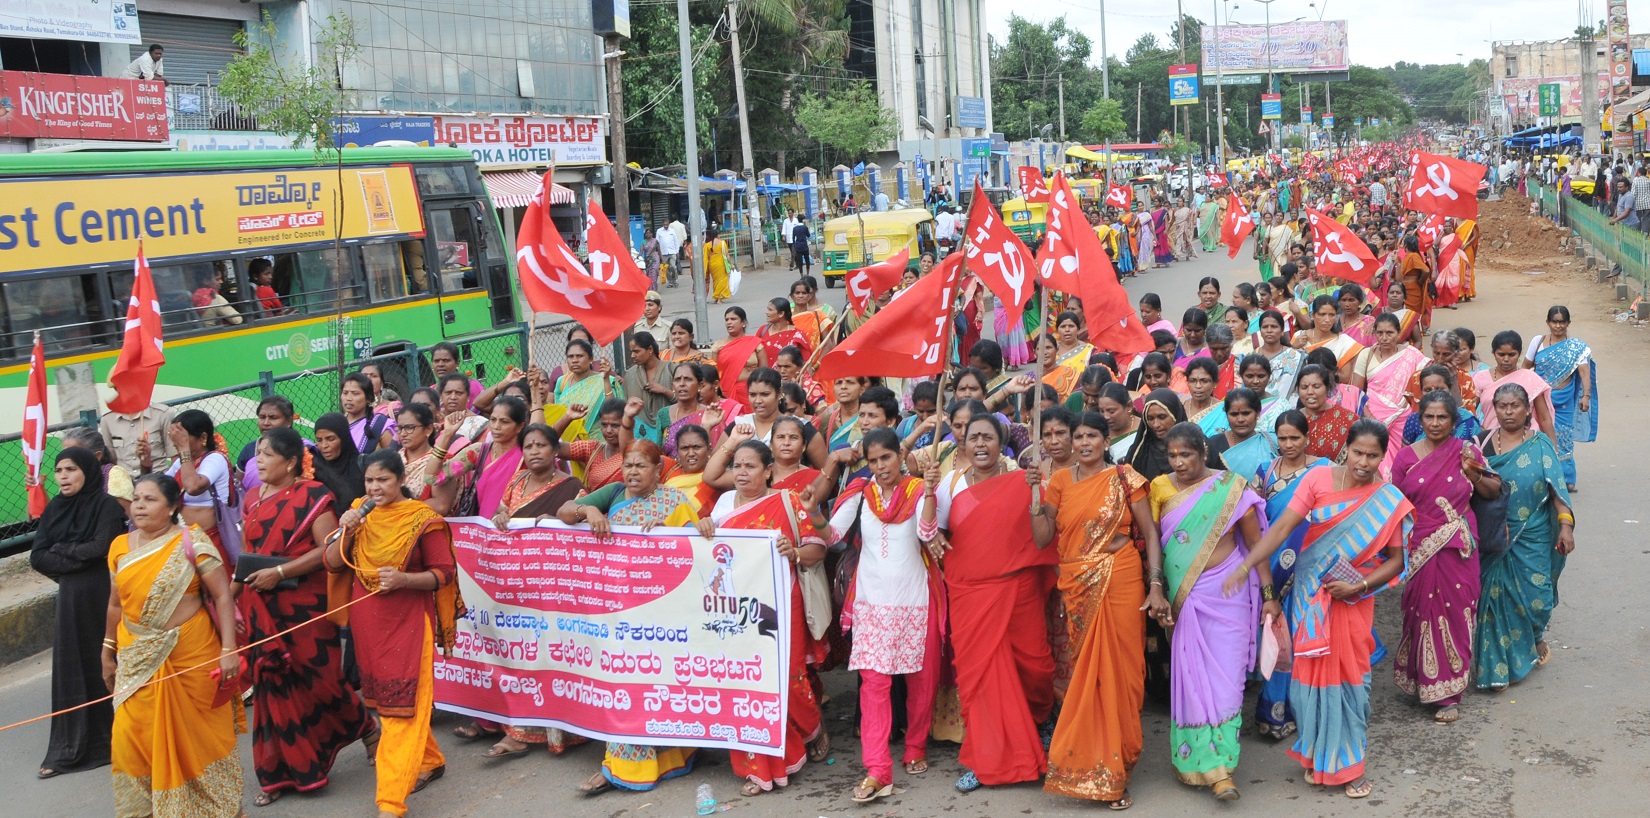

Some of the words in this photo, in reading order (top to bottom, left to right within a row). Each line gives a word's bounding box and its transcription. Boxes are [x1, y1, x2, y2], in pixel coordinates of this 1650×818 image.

[29, 17, 48, 25] Photo
[19, 86, 132, 124] KINGFISHER
[138, 84, 159, 93] SLN
[136, 96, 162, 106] WINES
[44, 118, 57, 127] The
[58, 120, 71, 128] King
[505, 116, 599, 148] ಹೋಟೆಲ್
[471, 149, 506, 163] OKA
[54, 197, 206, 246] Cement
[238, 234, 280, 246] Engineered
[294, 230, 325, 238] Concrete
[266, 344, 289, 360] CITY
[310, 334, 349, 352] SERVIE
[703, 594, 737, 615] CITU
[738, 597, 759, 626] 50
[480, 610, 489, 626] 10
[495, 610, 549, 639] ದೇಶವ್ಯಾಪಿ
[557, 617, 609, 639] ಅಂಗನವಾಡಿ
[615, 621, 688, 643] ನೌಕರರಿಂದ
[454, 630, 539, 662] ಲ್ಲಾಧಿಕಾರಿಗಳ
[549, 638, 594, 667] ಕಛೇರಿ
[600, 647, 662, 675] ಎದುರು
[673, 650, 763, 686] ಪ್ರತಿಭಟನೆ
[433, 660, 494, 689] ಕರ್ನಾಟಕ
[498, 673, 545, 707] ರಾಜ್ಯ
[552, 677, 632, 711] ಅಂಗನವಾಡಿ
[643, 684, 722, 716] ನೌಕರರ
[732, 692, 781, 725] ಸಂಘ
[646, 718, 706, 737] ತುಮಕೂರು
[710, 722, 739, 743] ಜಿಲ್ಲಾ
[740, 725, 770, 743] ಸಮಿತಿ
